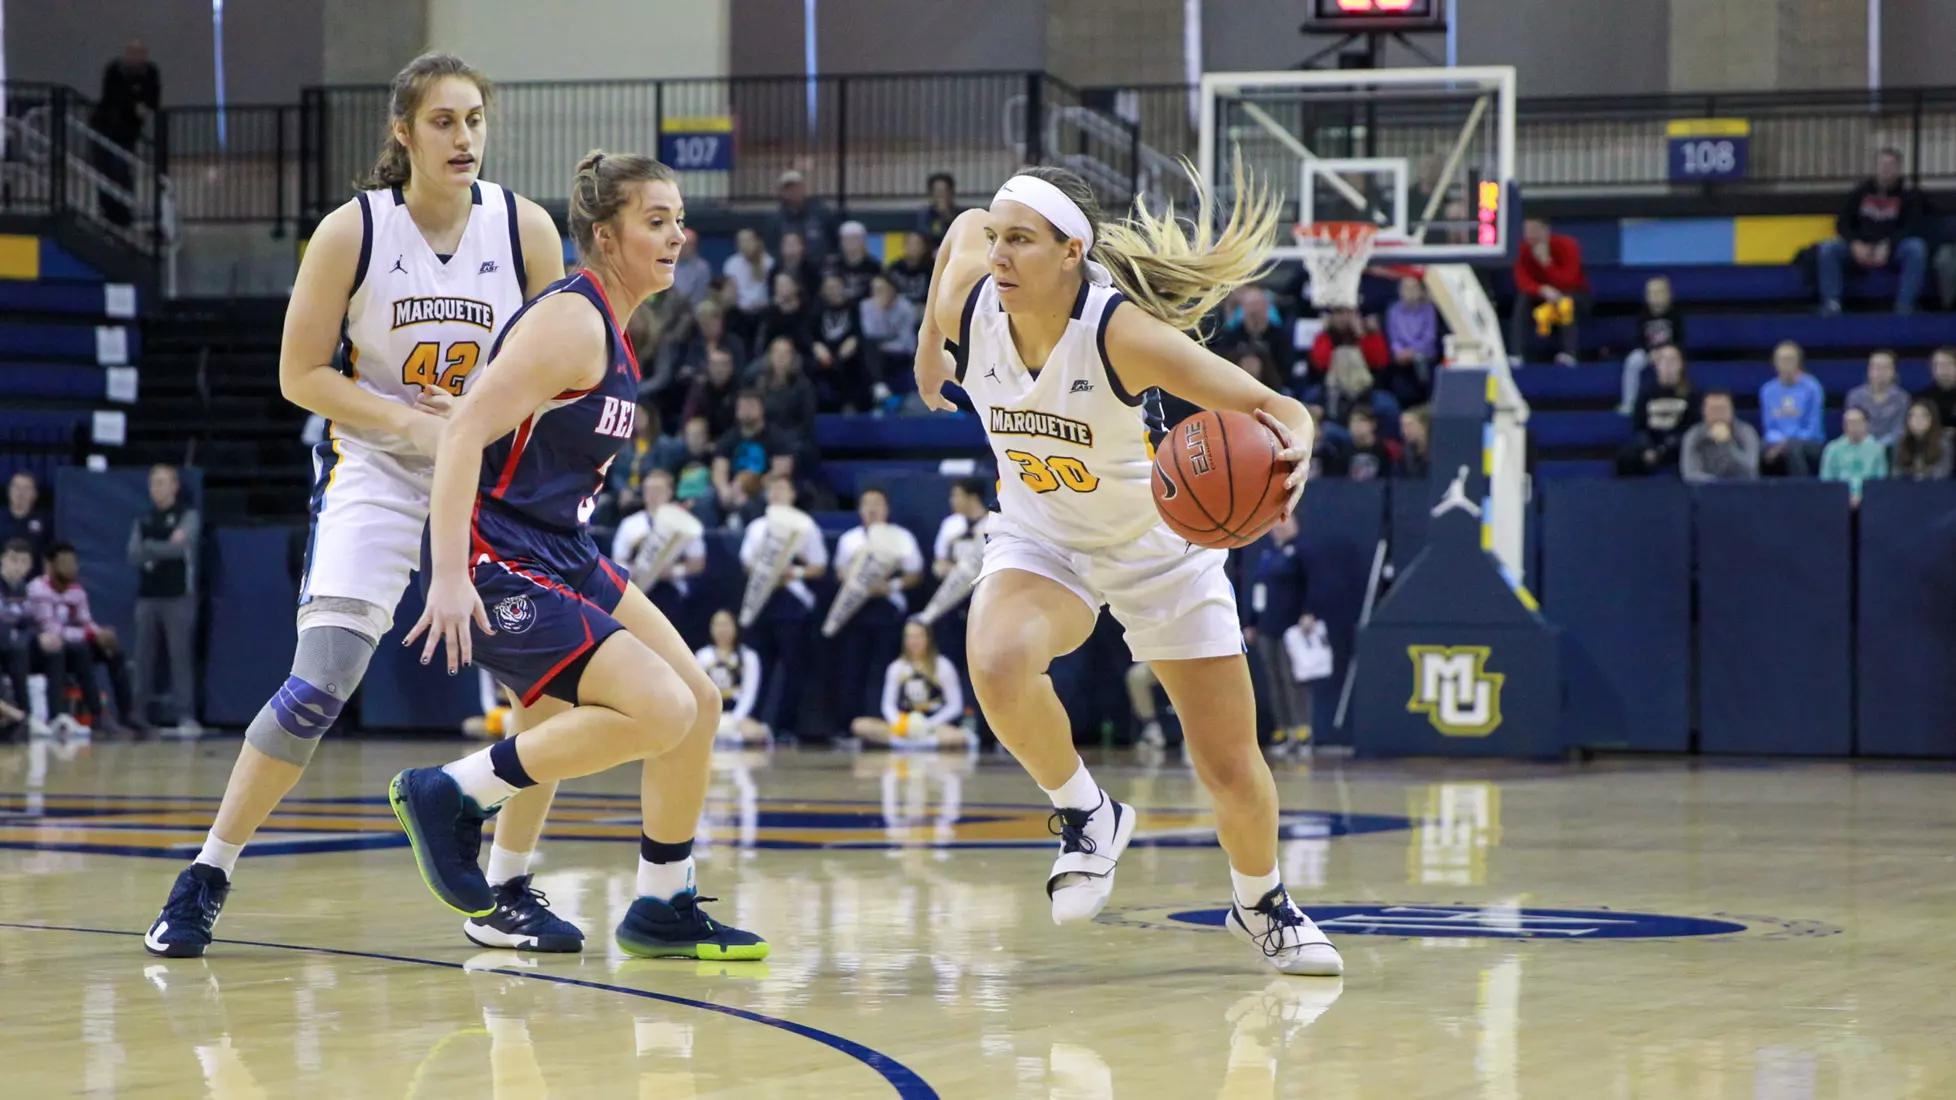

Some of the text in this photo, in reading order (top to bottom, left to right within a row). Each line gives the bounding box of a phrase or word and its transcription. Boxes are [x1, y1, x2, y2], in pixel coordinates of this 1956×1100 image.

[674, 136, 718, 167] 107
[1681, 141, 1735, 173] 108
[392, 297, 493, 331] MARQUETTE
[402, 341, 480, 397] 42
[990, 407, 1093, 447] MARQUETTE
[1185, 420, 1210, 477] ELITE
[1005, 449, 1100, 494] 30
[1412, 648, 1499, 733] MU
